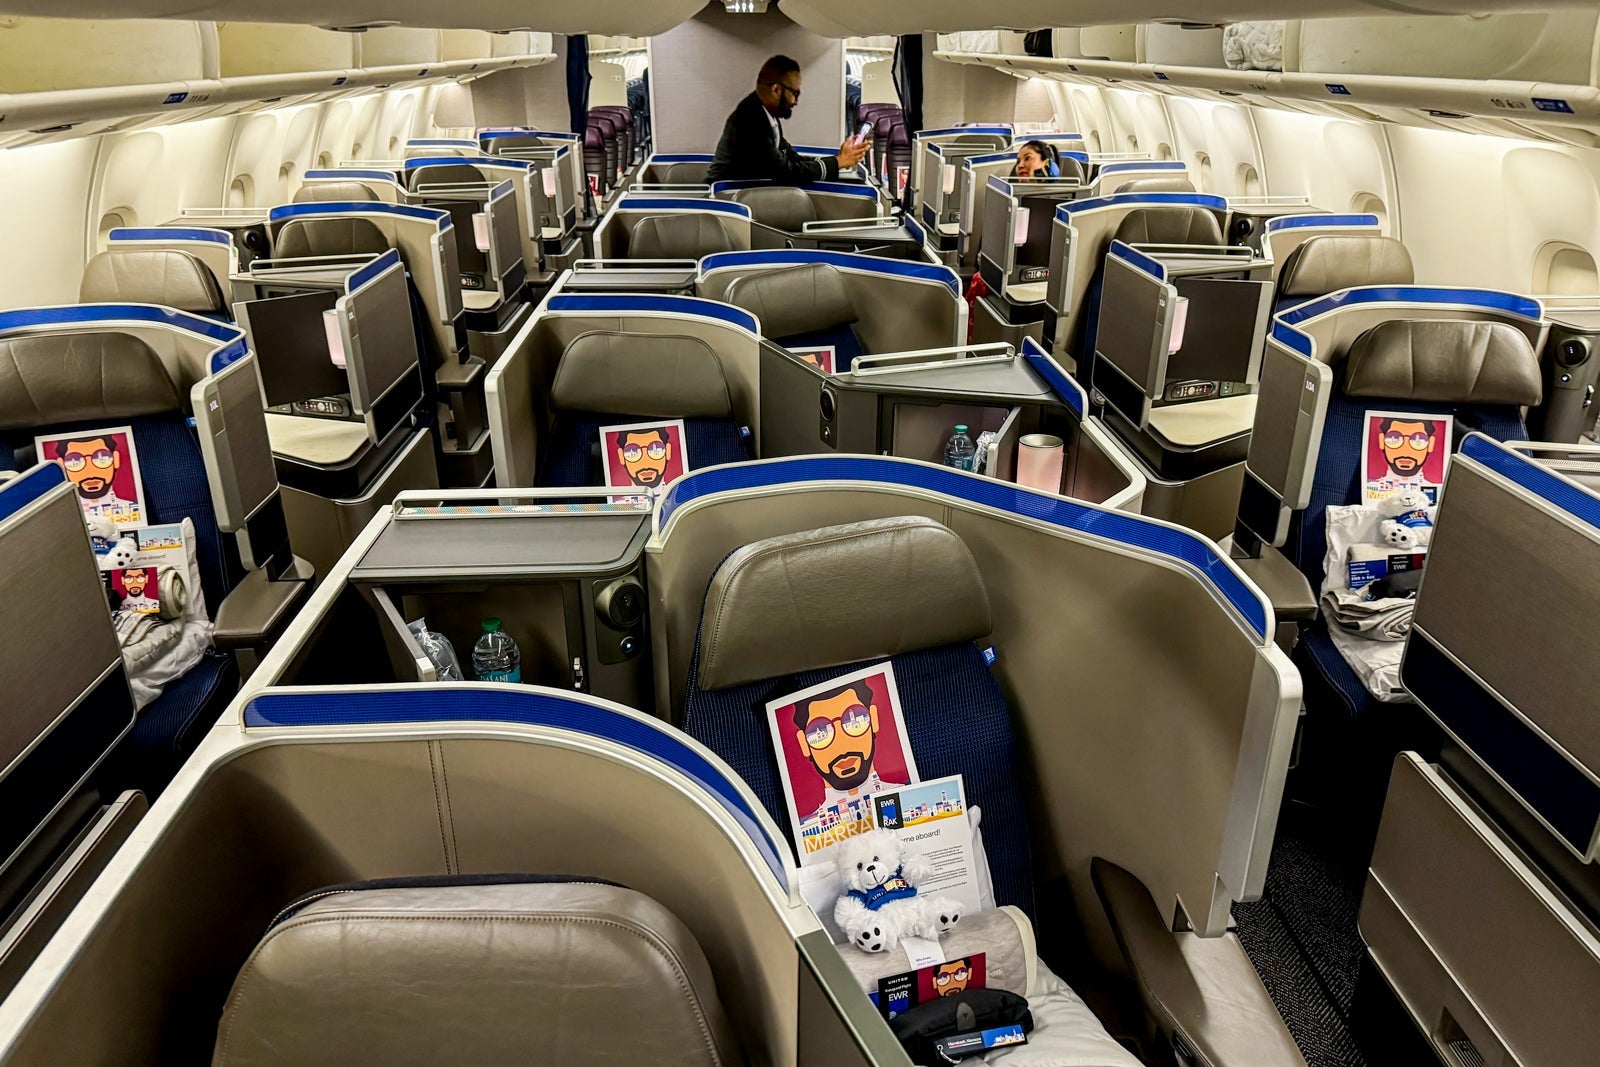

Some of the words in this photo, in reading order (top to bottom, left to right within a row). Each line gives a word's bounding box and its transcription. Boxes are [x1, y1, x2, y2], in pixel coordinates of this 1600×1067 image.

[480, 673, 509, 683] DASANI
[880, 798, 895, 808] EWR
[883, 818, 898, 827] RAK
[803, 816, 875, 853] MARRA
[915, 829, 941, 841] aboard!
[888, 990, 909, 1002] EWR
